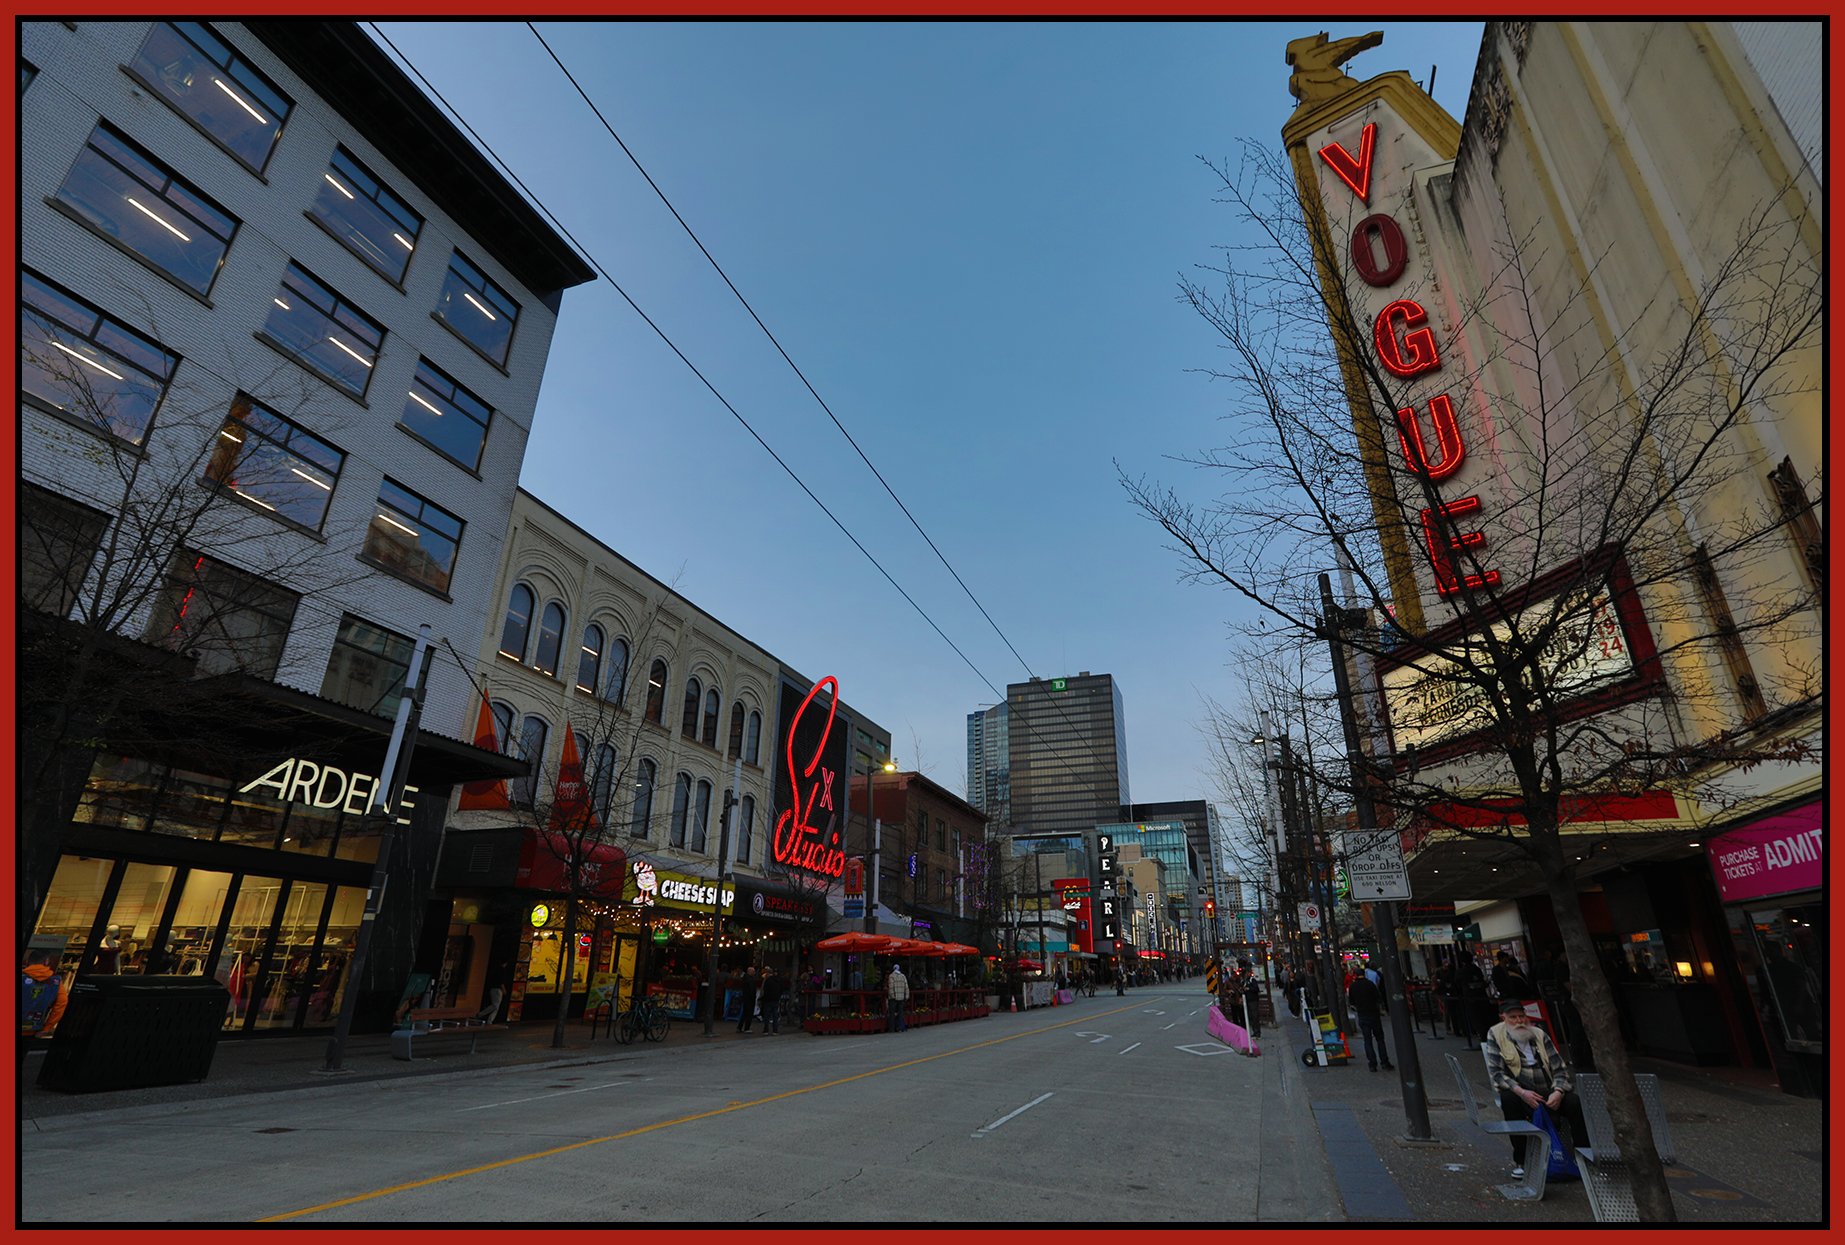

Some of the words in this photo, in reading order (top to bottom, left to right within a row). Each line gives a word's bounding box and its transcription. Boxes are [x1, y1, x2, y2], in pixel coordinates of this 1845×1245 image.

[1318, 122, 1502, 600] VOGUE
[1053, 680, 1066, 690] TD
[1353, 836, 1367, 845] NO
[1368, 853, 1381, 862] OR
[1719, 846, 1760, 868] PURCHASE
[1352, 863, 1375, 872] DROP
[1380, 862, 1401, 870] OFFS
[1723, 863, 1756, 881] TICKETS
[1755, 861, 1764, 873] AT
[661, 879, 706, 904] CHEESE
